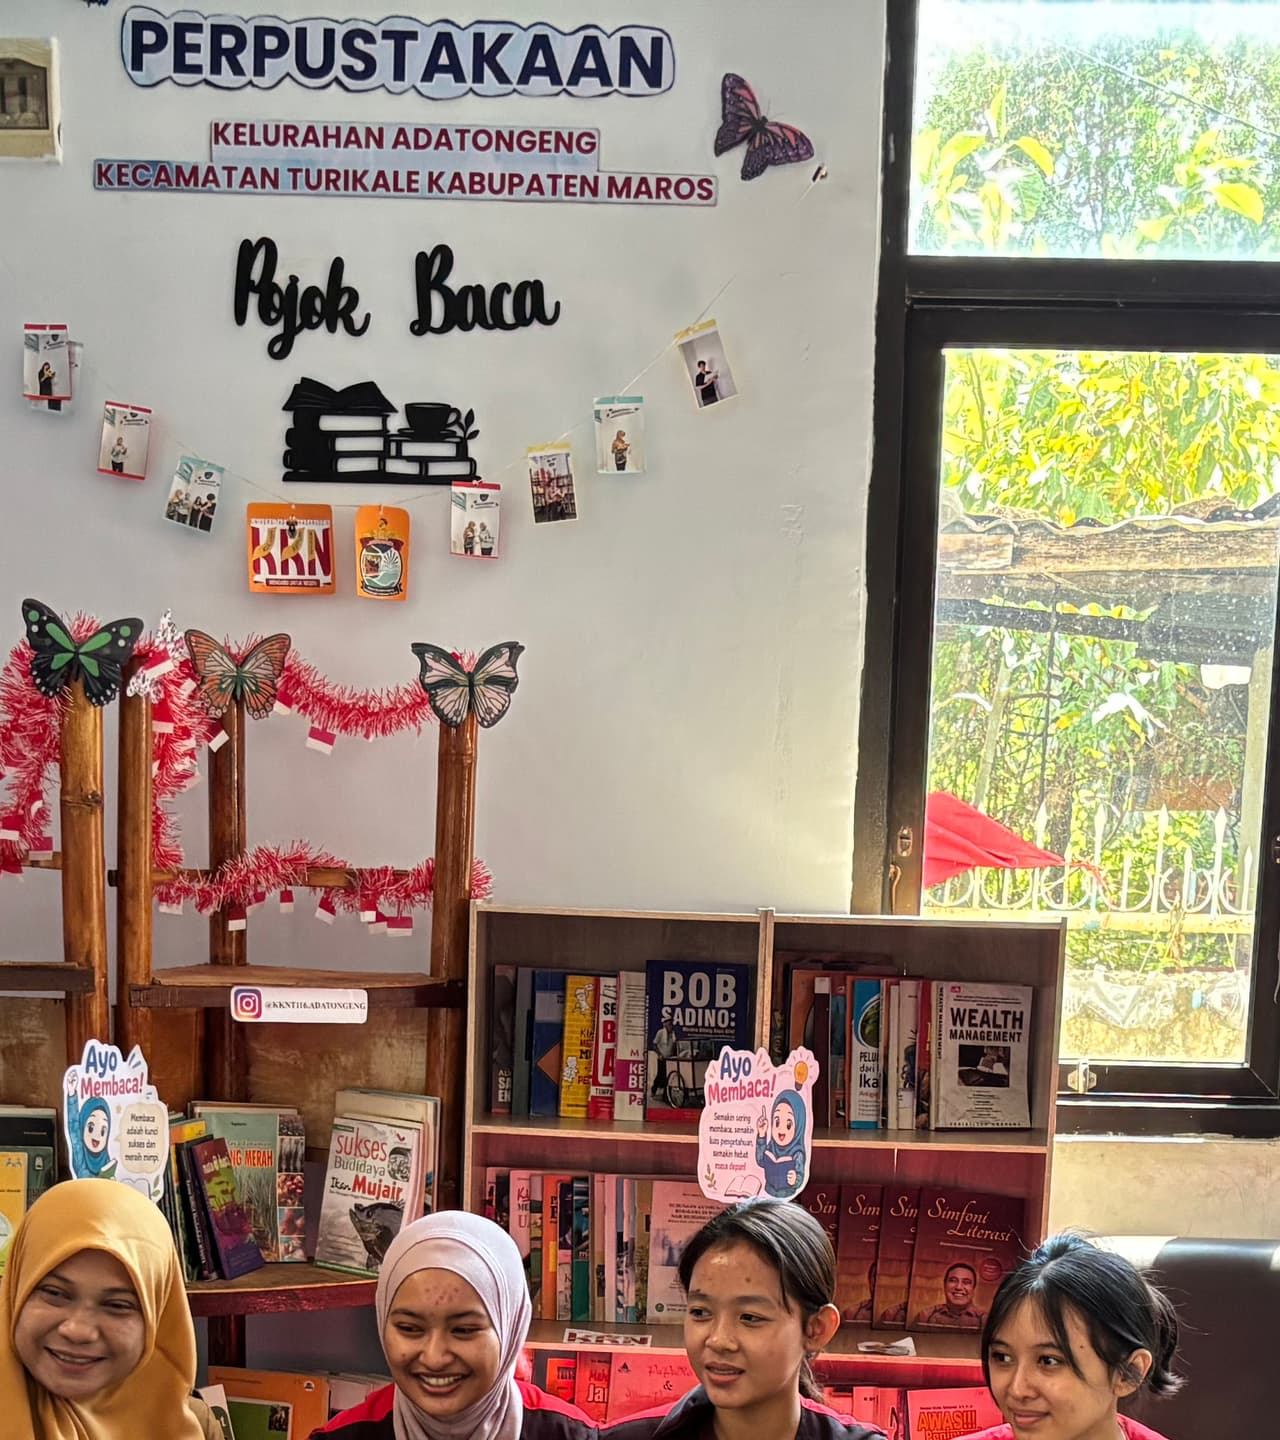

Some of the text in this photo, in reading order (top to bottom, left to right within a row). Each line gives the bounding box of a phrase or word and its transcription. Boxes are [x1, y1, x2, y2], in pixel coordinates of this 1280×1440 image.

[130, 19, 666, 90] PERPUSTAKAAN
[213, 122, 597, 155] KELURAHAN ADATONGENG
[95, 163, 715, 202] KECAMATAN TURIKALE KABUPATEN MAROS
[234, 236, 561, 360] Pojok Baca
[663, 971, 737, 1008] BOB
[661, 1007, 736, 1028] SADINO:
[950, 1007, 1024, 1030] WEALTH
[949, 1029, 1022, 1043] MANAGEMENT
[85, 1045, 117, 1078] Ayo
[720, 1051, 751, 1082] Ayo
[80, 1072, 144, 1099] Membaca!
[708, 1074, 776, 1106] Membaca!
[859, 1074, 880, 1088] Ika
[131, 1113, 155, 1123] Membaca
[714, 1112, 735, 1121] Semakin
[245, 1150, 273, 1168] MERAH
[334, 1155, 386, 1179] Budidaya
[352, 1174, 404, 1201] Mujair
[927, 1197, 990, 1228] Simfoni
[946, 1221, 1011, 1242] Literasi
[917, 1410, 977, 1432] AWAS!!!
